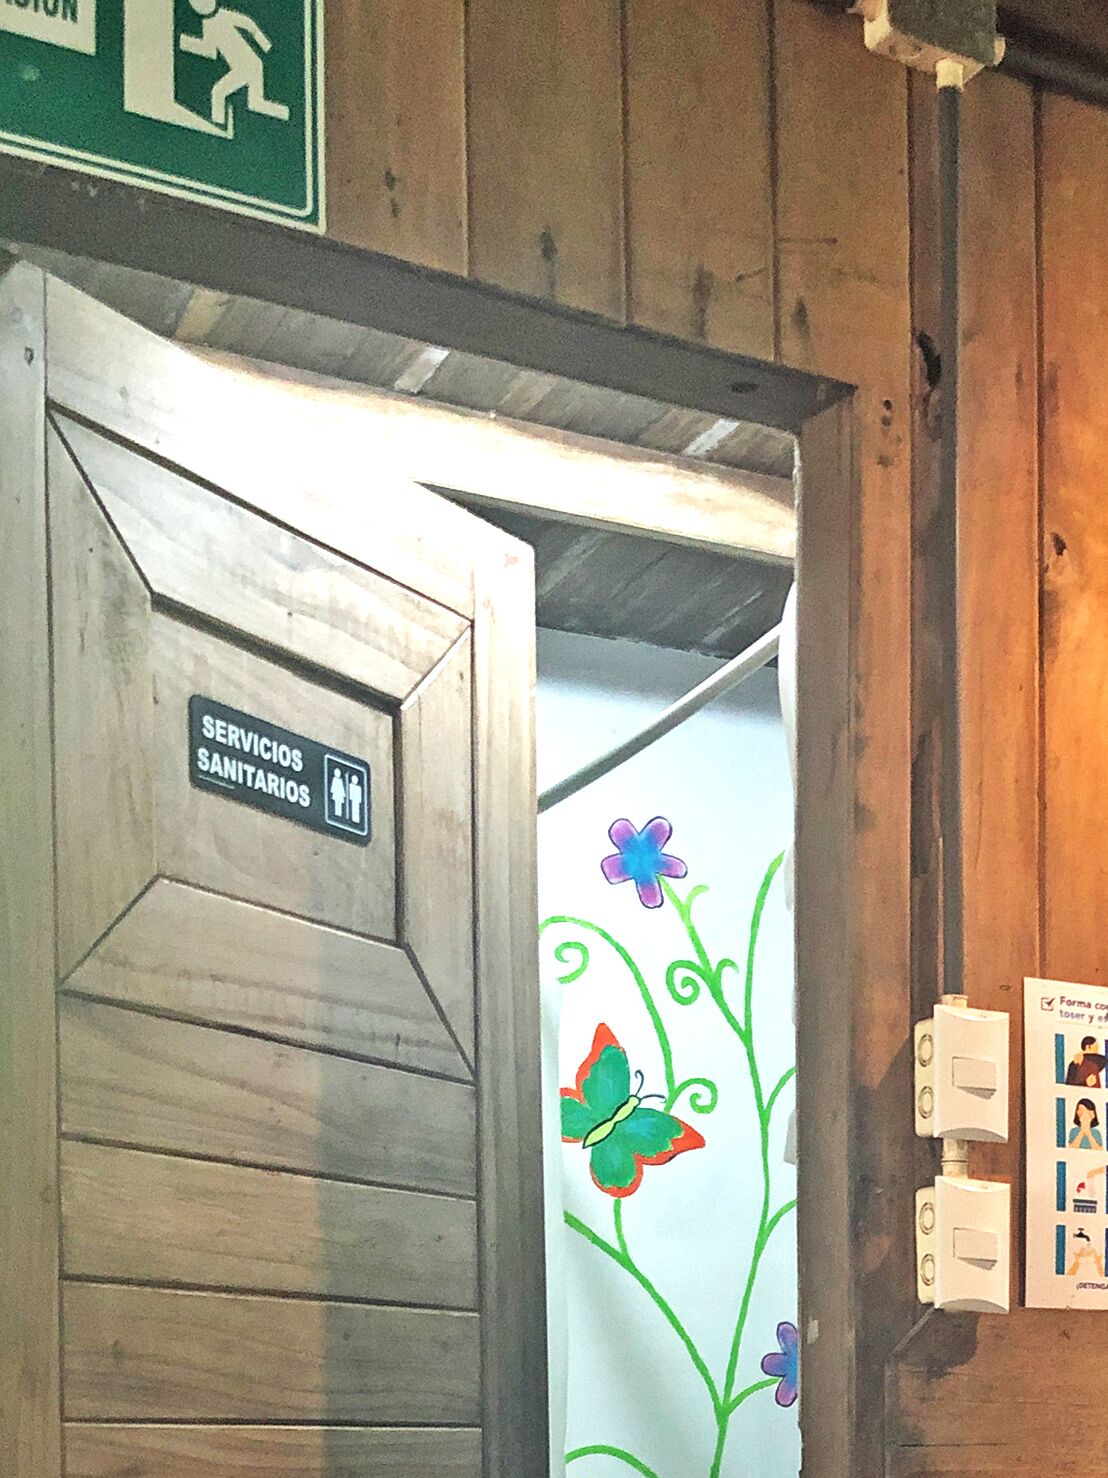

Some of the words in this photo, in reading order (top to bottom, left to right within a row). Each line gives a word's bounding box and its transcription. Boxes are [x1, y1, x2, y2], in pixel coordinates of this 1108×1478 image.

[202, 715, 303, 773] SERVICIOS
[197, 747, 311, 807] SANITARIOS
[1059, 996, 1092, 1009] Forma
[1059, 1009, 1085, 1020] toser
[1088, 1014, 1095, 1024] y
